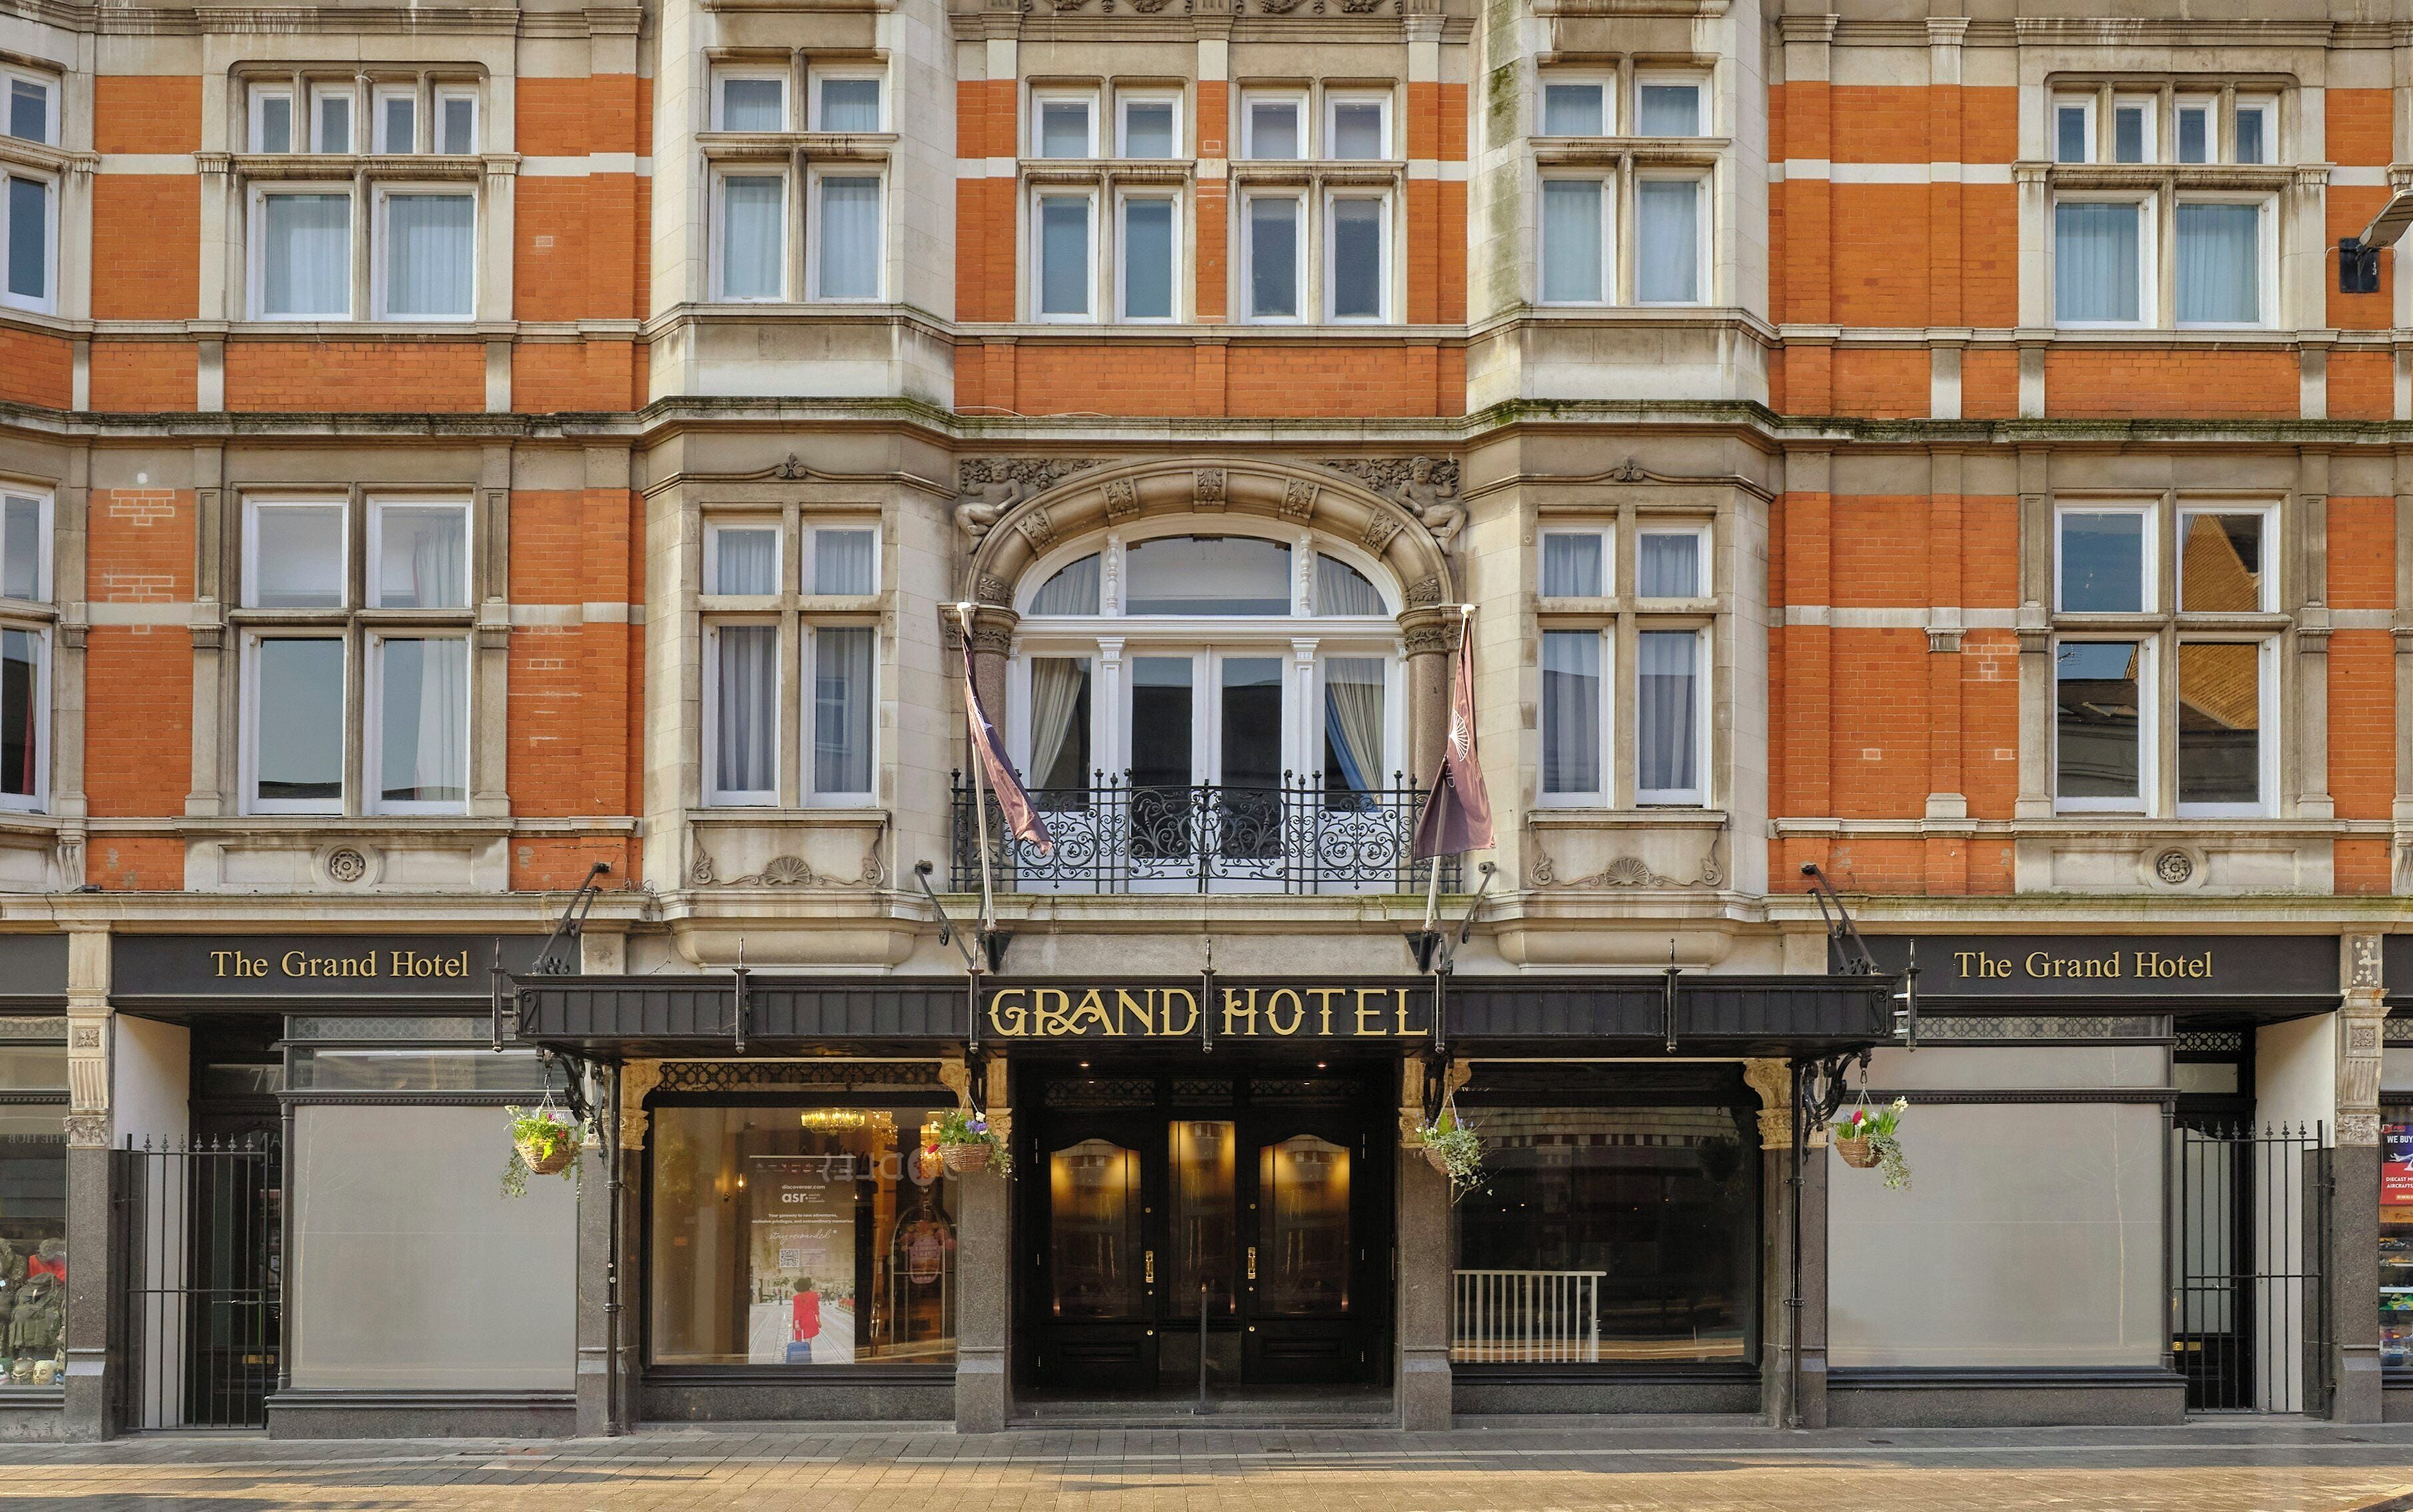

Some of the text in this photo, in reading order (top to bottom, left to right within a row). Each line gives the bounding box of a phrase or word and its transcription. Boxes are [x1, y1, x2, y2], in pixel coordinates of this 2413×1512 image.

[211, 950, 469, 977] The Grand Hotel
[1954, 951, 2212, 978] The Grand Hotel
[988, 988, 1428, 1036] GRAND HOTEL
[249, 1068, 281, 1092] 77
